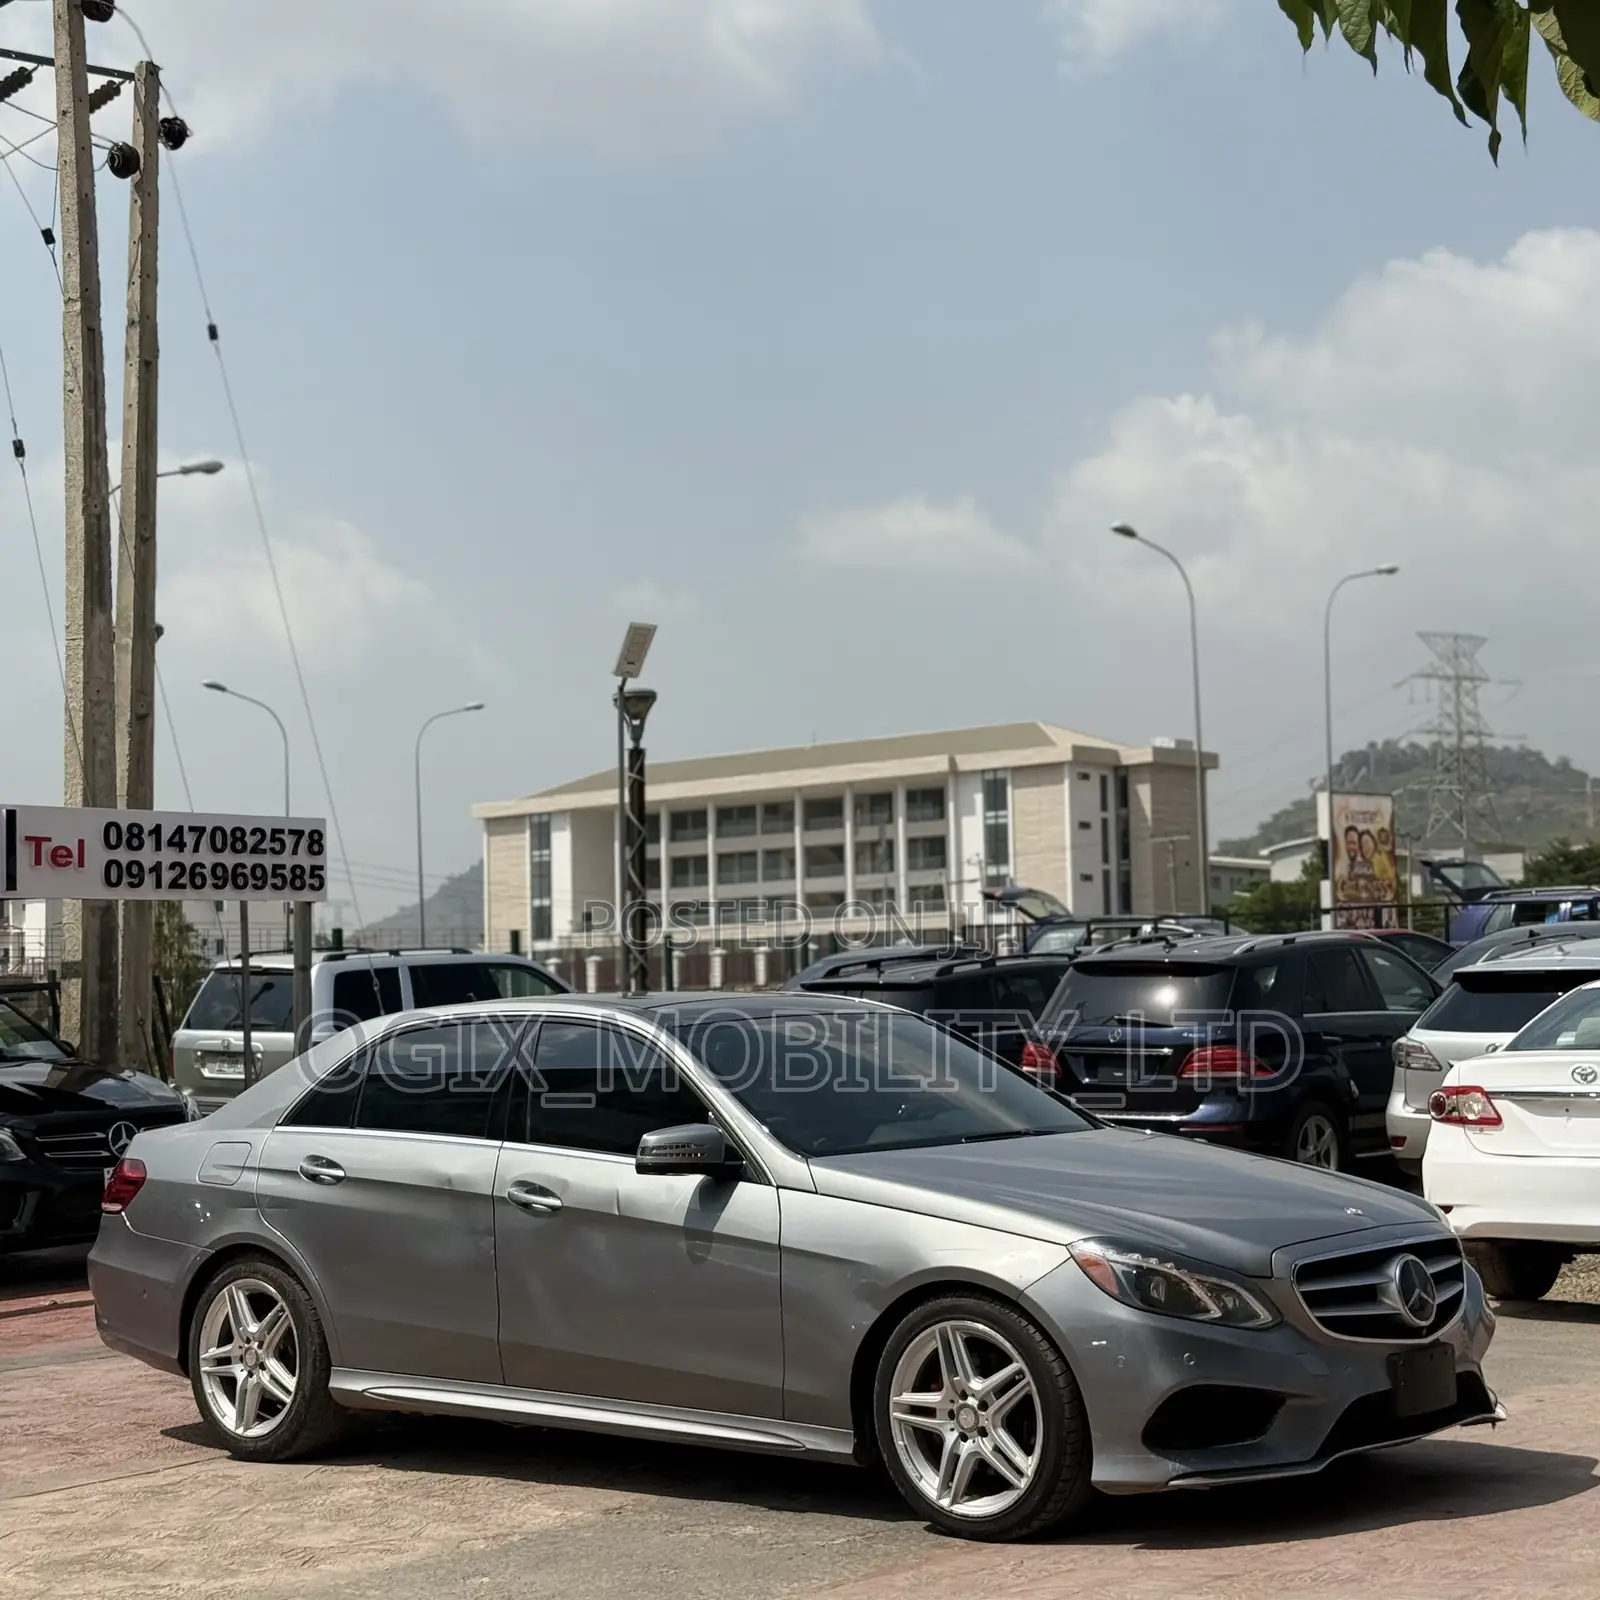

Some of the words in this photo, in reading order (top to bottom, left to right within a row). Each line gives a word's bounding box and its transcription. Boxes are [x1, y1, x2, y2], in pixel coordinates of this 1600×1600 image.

[24, 835, 86, 869] Tel
[102, 820, 325, 857] 08147082578
[103, 859, 326, 892] 09126969585
